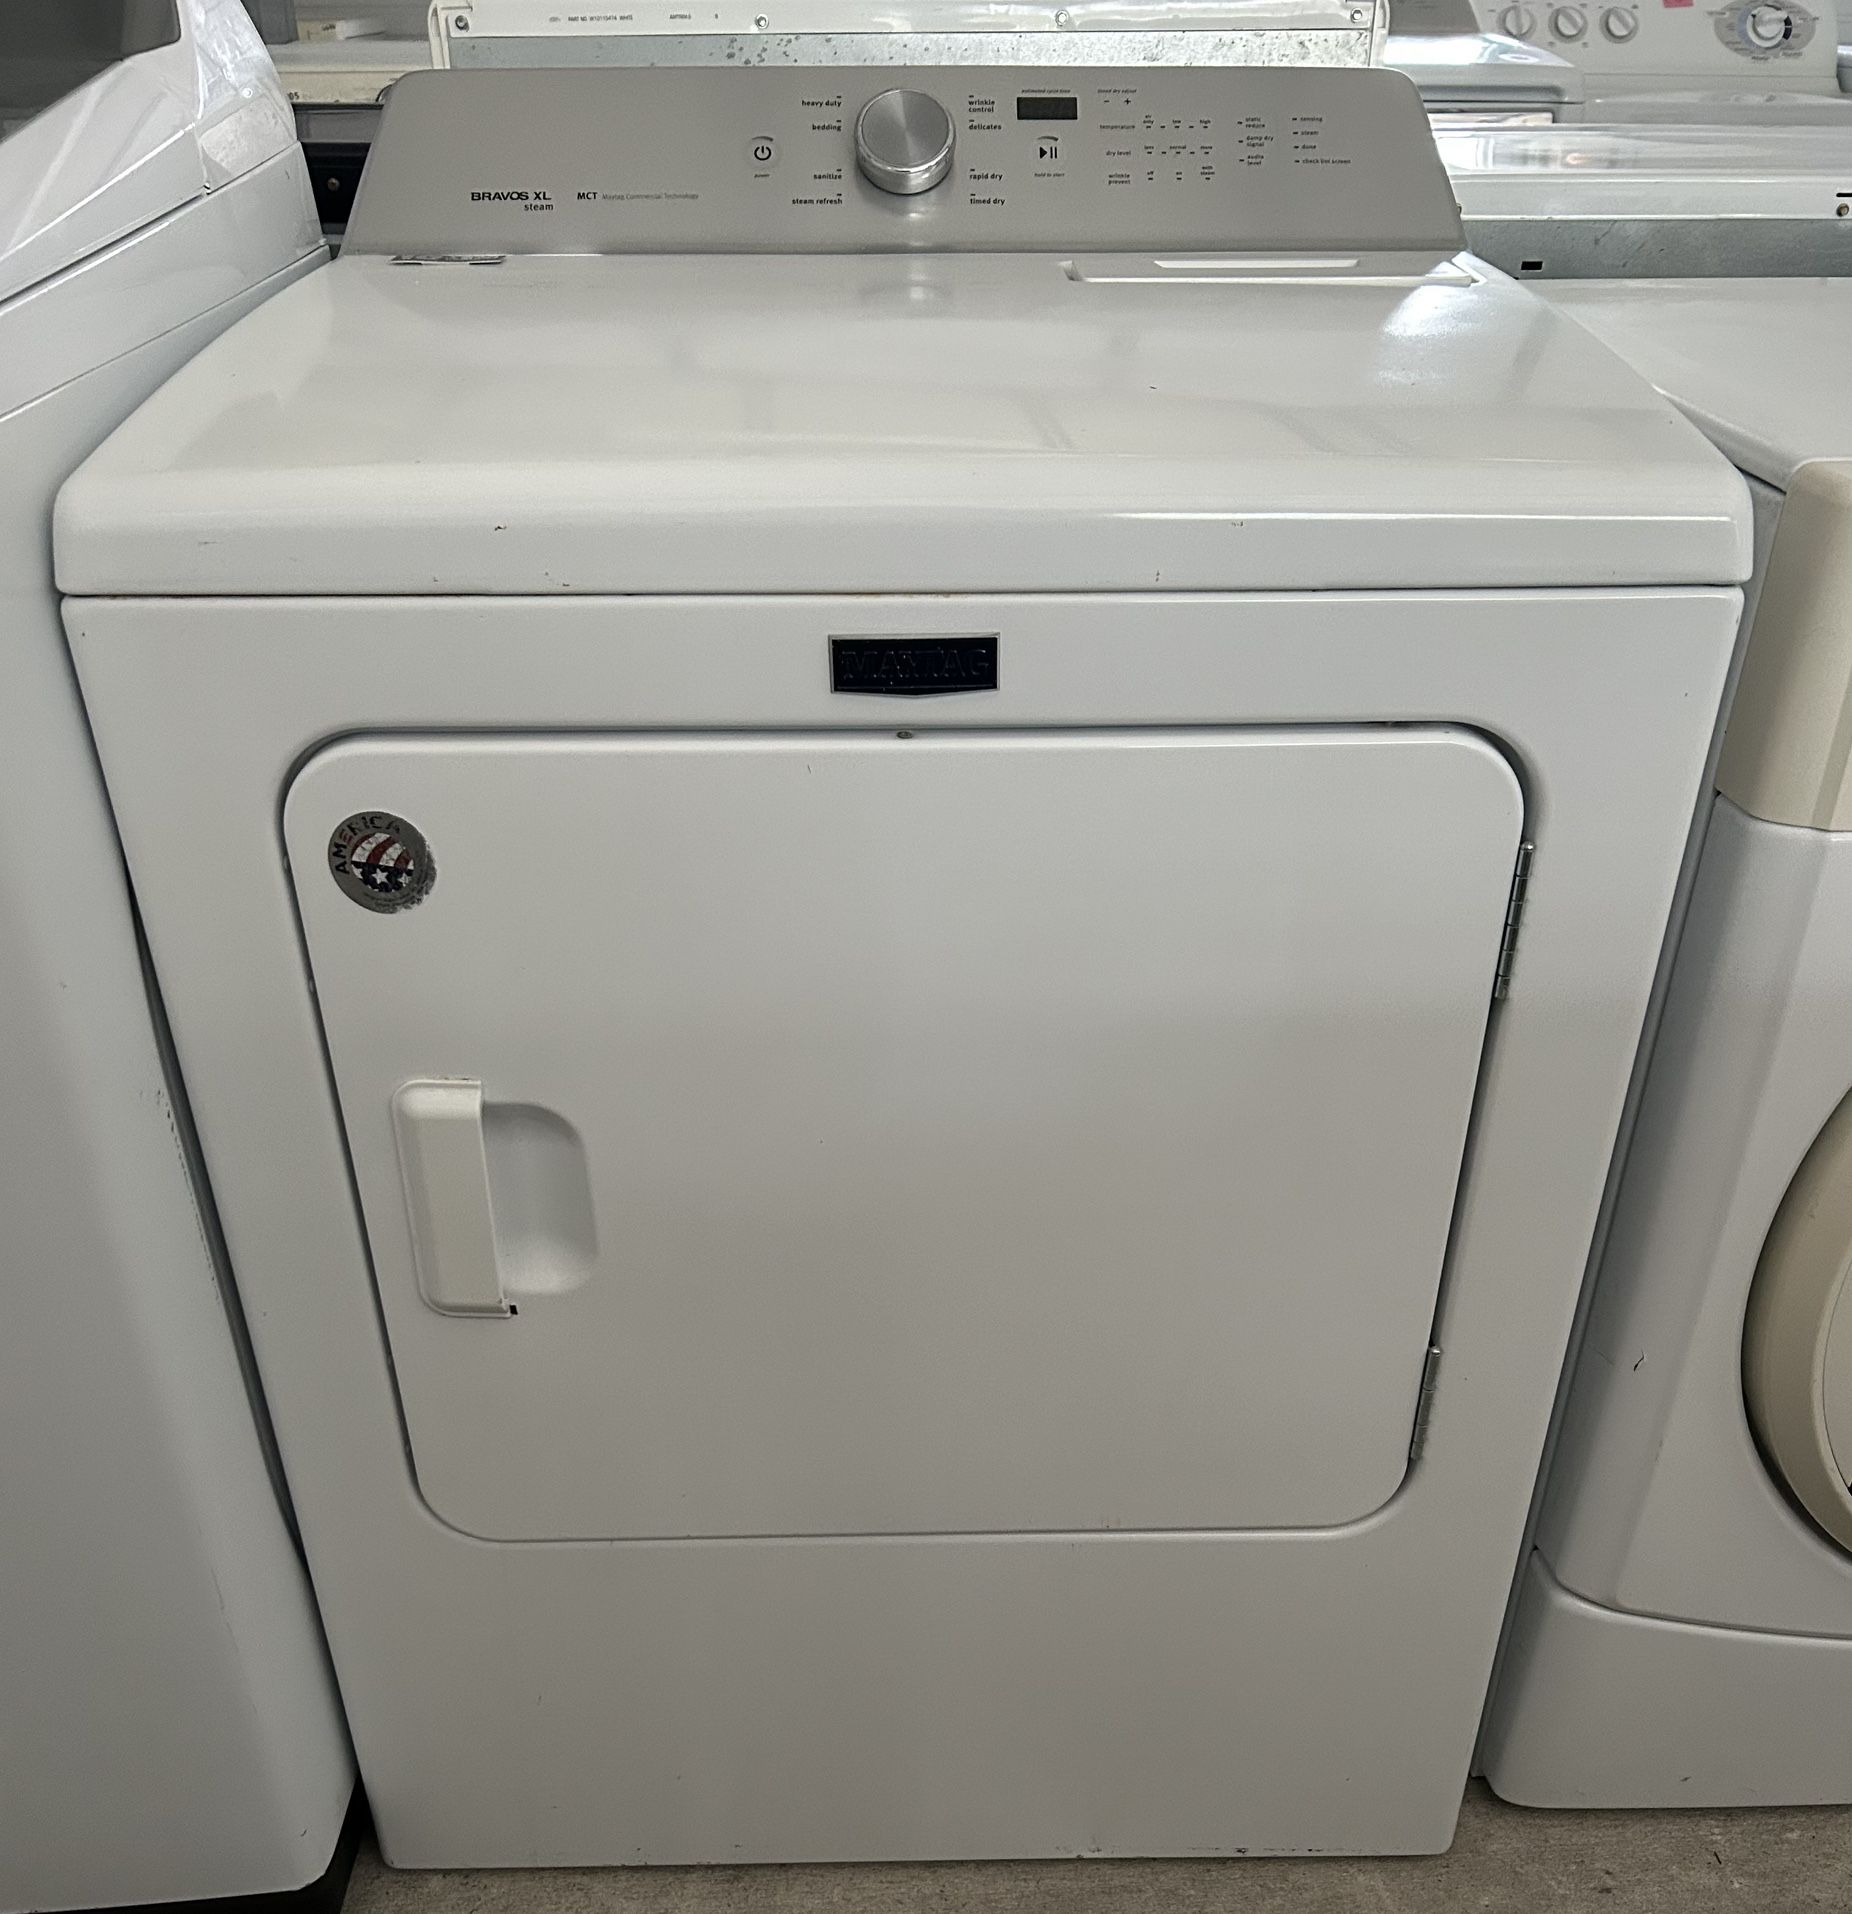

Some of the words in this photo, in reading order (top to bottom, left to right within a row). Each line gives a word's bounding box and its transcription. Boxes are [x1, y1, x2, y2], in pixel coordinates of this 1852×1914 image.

[470, 191, 529, 201] BRAVOS
[533, 191, 552, 201] XL
[577, 192, 598, 200] MCT
[524, 203, 554, 211] steam
[841, 648, 990, 680] MAYTAG
